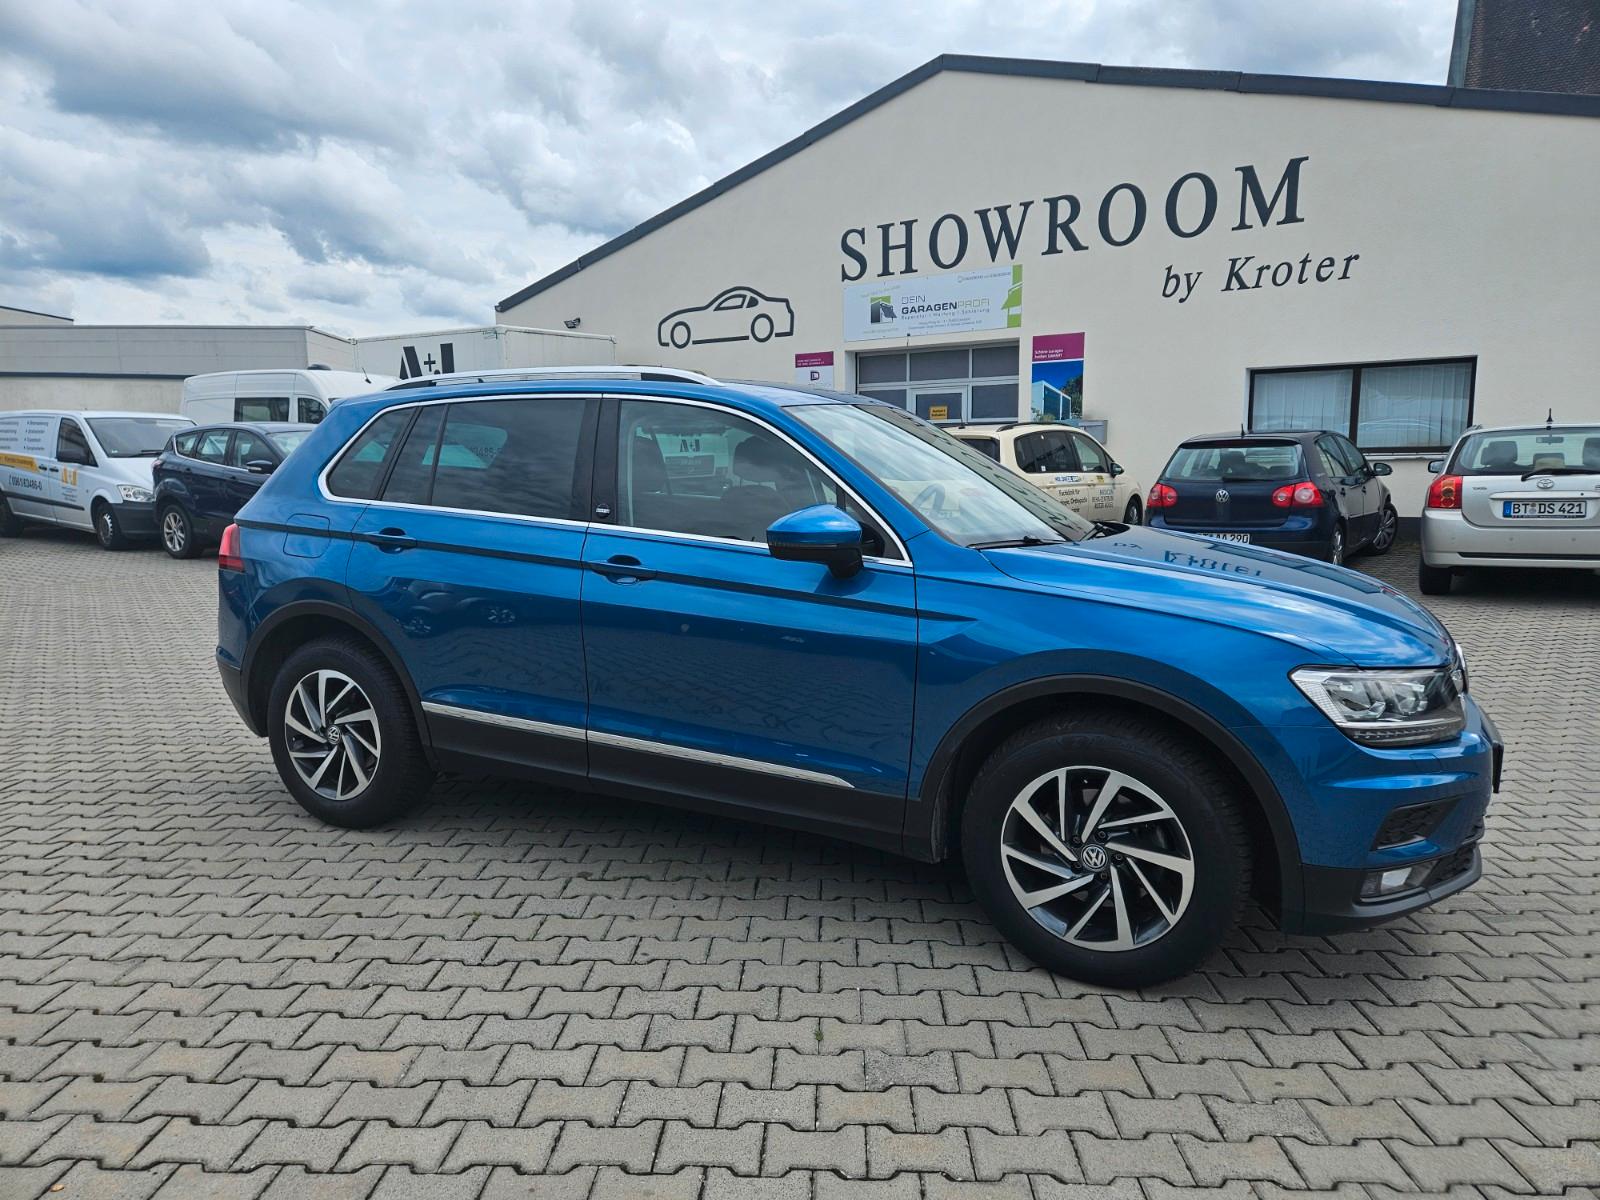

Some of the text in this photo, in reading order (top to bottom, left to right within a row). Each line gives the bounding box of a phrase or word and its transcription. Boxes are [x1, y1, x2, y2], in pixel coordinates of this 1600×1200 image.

[840, 155, 1310, 282] SHOWROOM
[1161, 252, 1360, 303] by Kroter
[901, 295, 926, 305] DEIN
[1512, 503, 1530, 514] BT
[1537, 503, 1555, 514] DS
[1558, 503, 1583, 514] 421
[1230, 534, 1249, 544] 290
